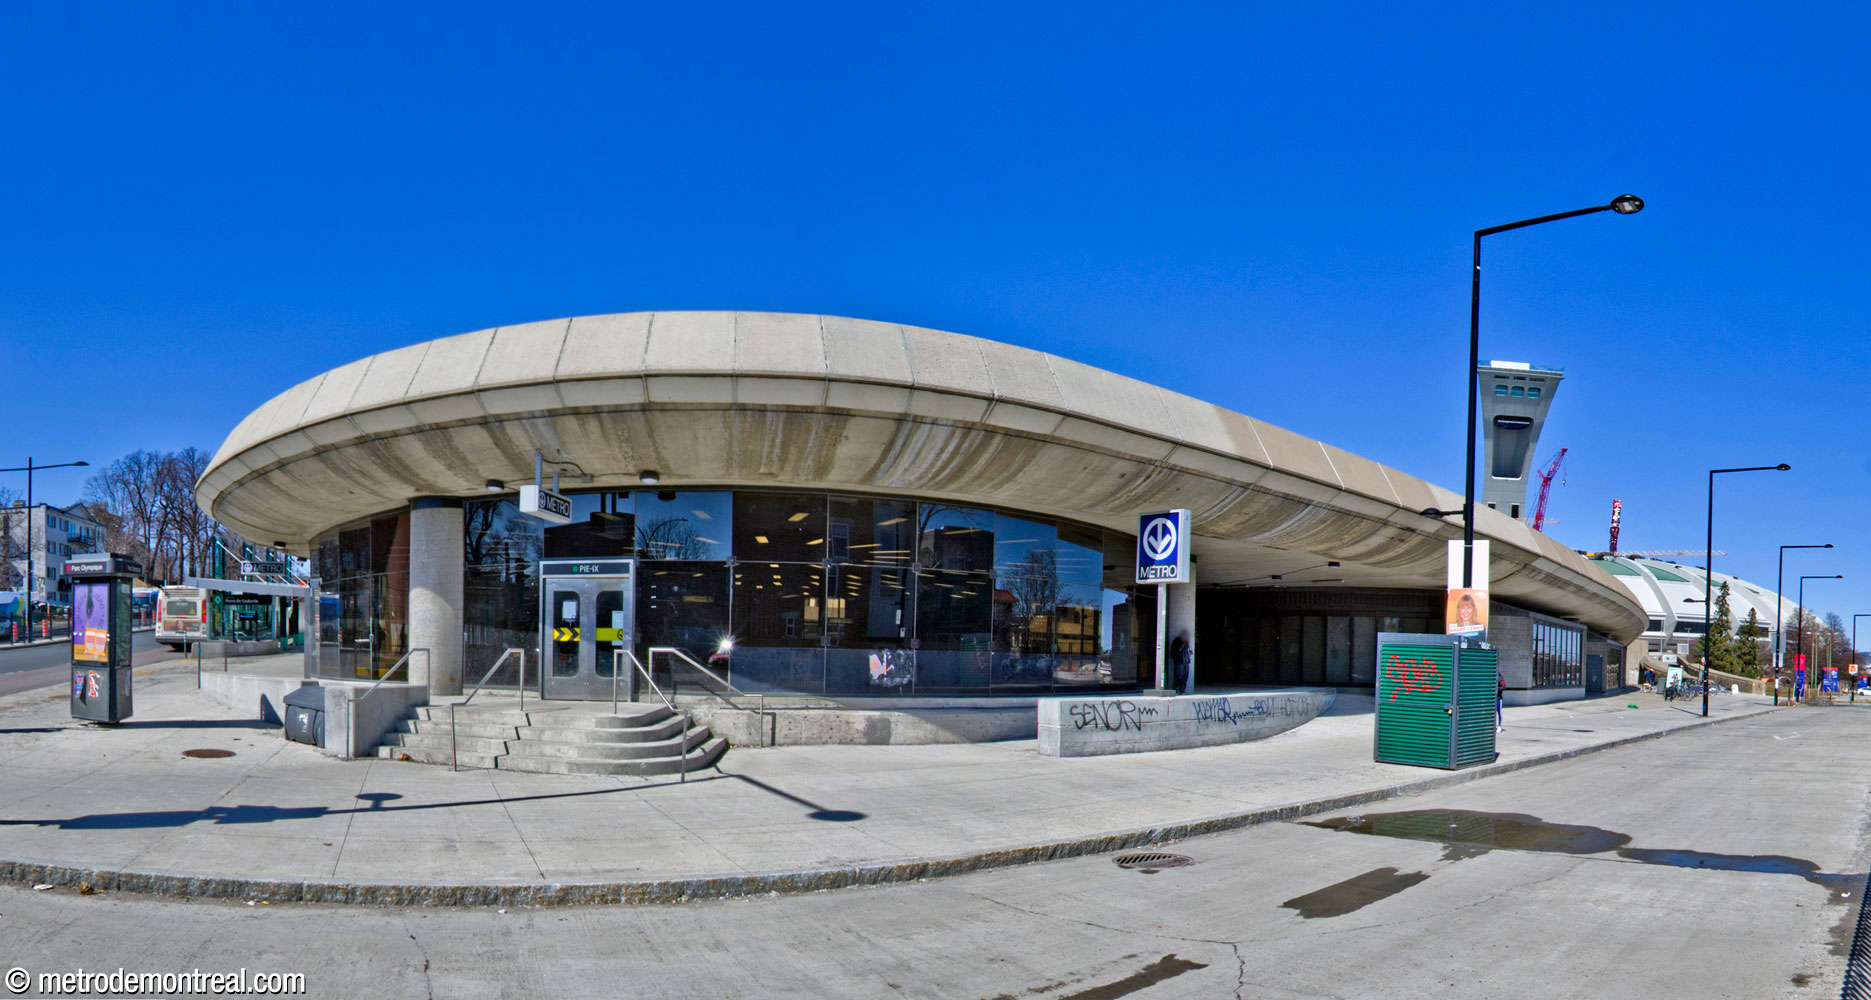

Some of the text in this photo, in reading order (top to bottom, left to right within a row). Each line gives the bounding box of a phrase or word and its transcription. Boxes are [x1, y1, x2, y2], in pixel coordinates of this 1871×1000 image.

[547, 495, 570, 516] METRO
[81, 564, 103, 573] Olympique
[579, 565, 600, 573] PIE-IX
